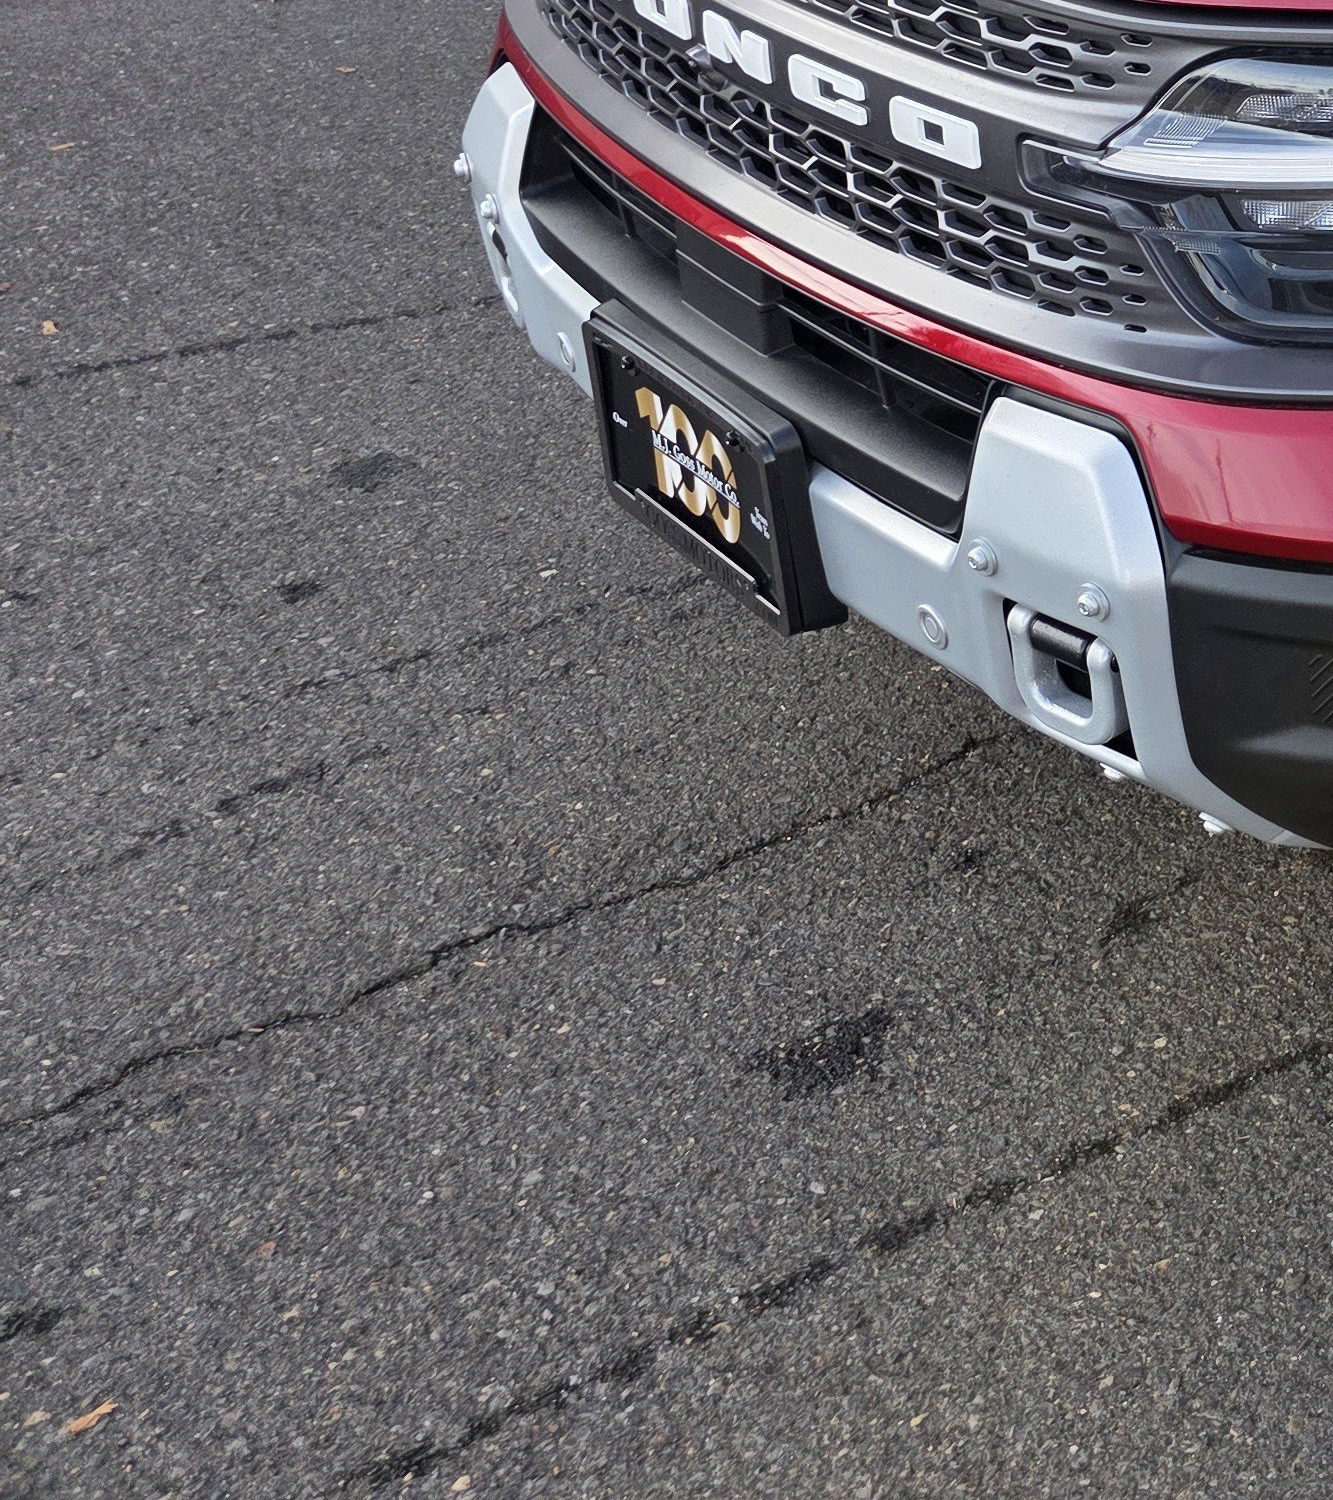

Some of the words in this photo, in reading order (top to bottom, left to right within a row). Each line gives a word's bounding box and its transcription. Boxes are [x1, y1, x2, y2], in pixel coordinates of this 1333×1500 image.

[635, 387, 741, 543] 100
[696, 460, 723, 492] Motor
[725, 482, 740, 508] Co.
